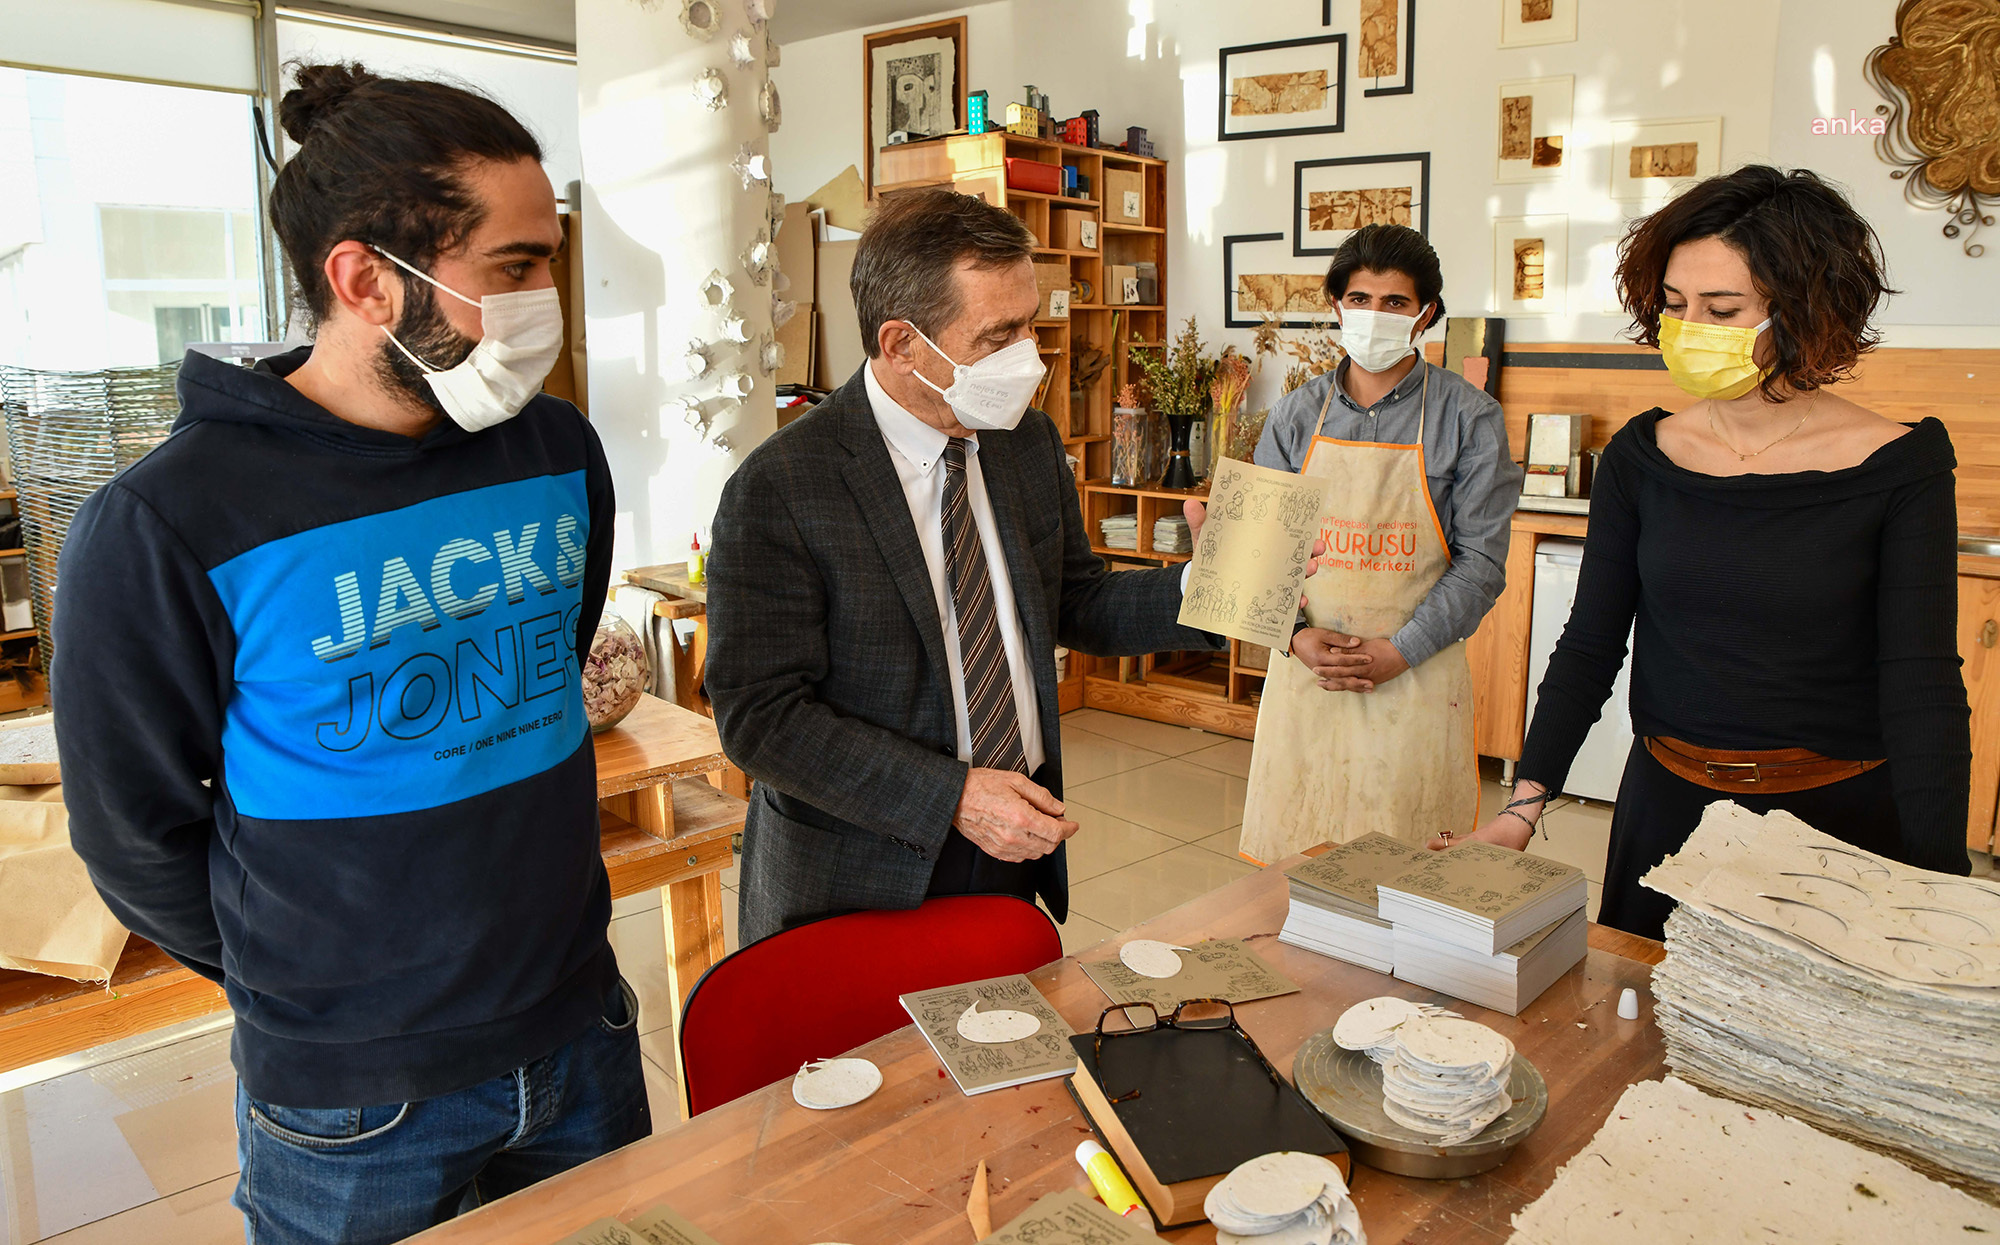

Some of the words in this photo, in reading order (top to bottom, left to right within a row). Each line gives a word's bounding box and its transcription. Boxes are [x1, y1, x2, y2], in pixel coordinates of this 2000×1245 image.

[1360, 558, 1415, 572] Merkezi
[311, 521, 556, 664] JACK
[434, 745, 467, 761] CORE
[475, 736, 495, 751] ONE
[496, 727, 518, 744] NINE
[519, 719, 541, 736] NINE
[542, 710, 563, 727] ZERO
